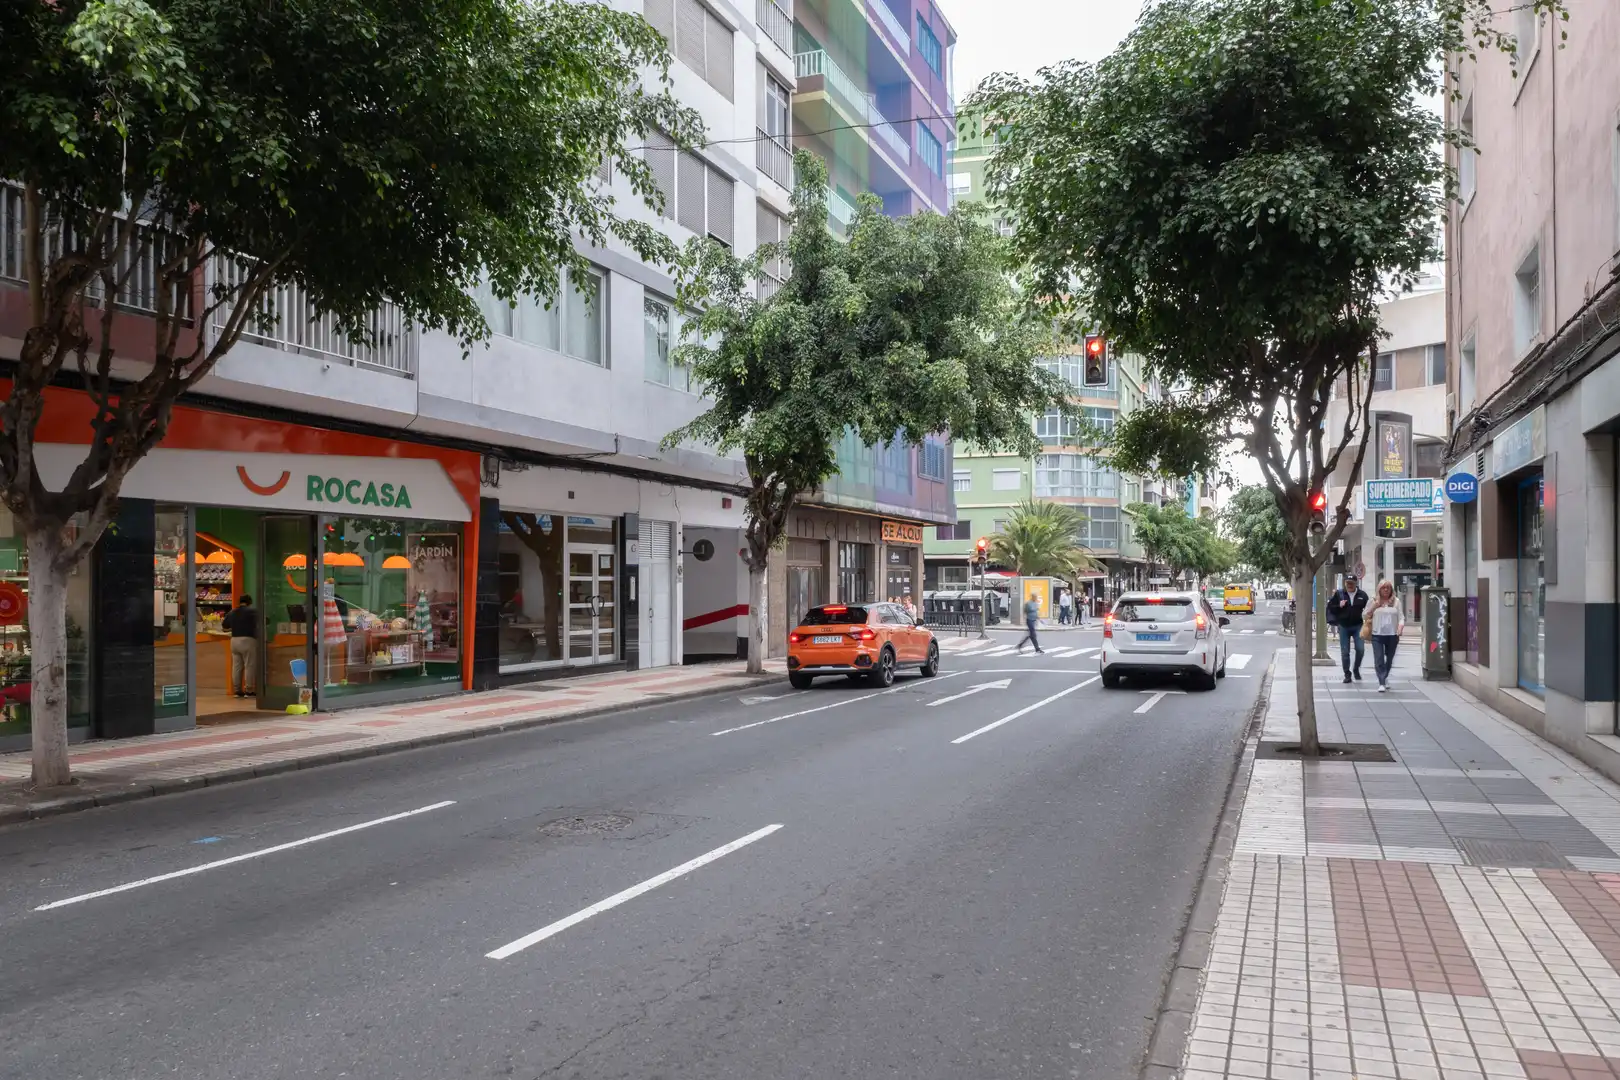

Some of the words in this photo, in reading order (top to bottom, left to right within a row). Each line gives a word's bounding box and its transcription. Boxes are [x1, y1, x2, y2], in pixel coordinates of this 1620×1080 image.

[307, 475, 412, 509] ROCASA
[1369, 482, 1431, 499] SUPERMERCADO
[1448, 481, 1474, 491] DIGI
[1385, 516, 1406, 529] 9:55
[883, 524, 894, 538] SE
[414, 543, 453, 560] JARDÍN
